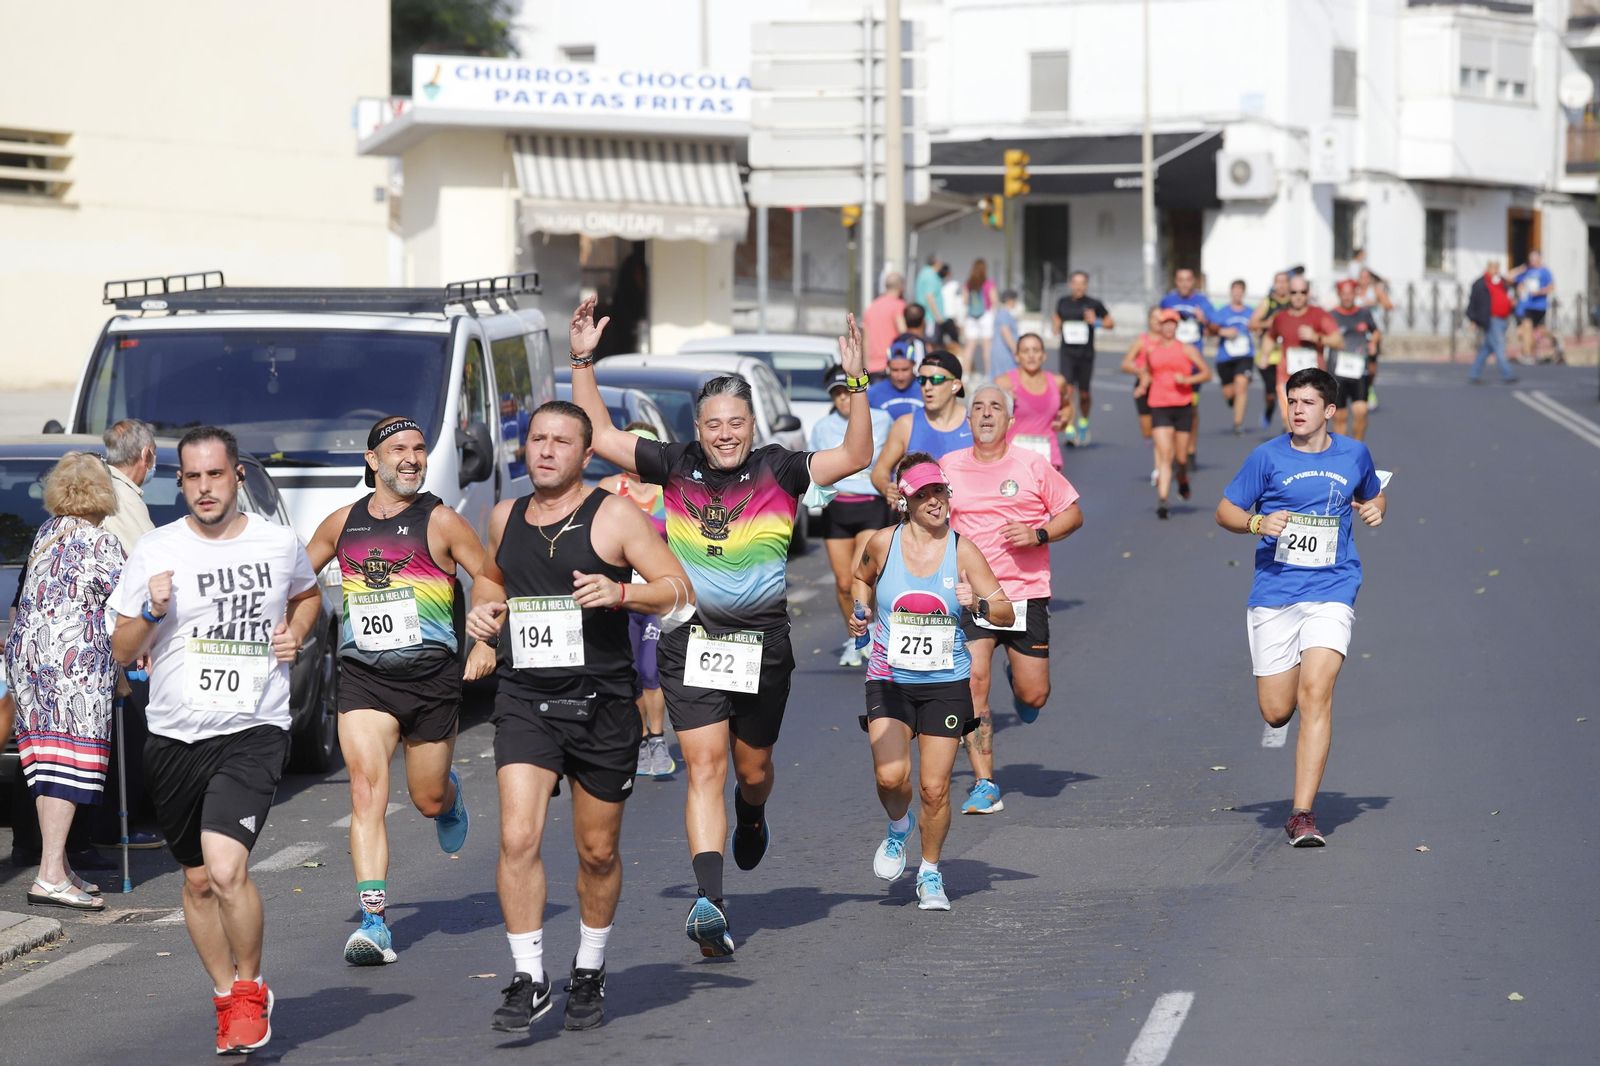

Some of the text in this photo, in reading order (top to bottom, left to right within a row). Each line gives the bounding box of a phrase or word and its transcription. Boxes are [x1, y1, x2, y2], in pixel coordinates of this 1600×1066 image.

[455, 64, 590, 86] CHURROS
[619, 71, 752, 90] CHOCOLA
[494, 89, 734, 113] PATATAS FRITAS
[404, 421, 420, 430] MA
[1293, 470, 1318, 480] VUELTA
[1325, 471, 1348, 486] HUELVA
[1291, 515, 1337, 527] VUELTA A HUELVA
[1287, 533, 1318, 553] 240
[197, 562, 272, 596] PUSH
[212, 591, 266, 622] THE
[357, 594, 379, 604] VUELTA
[380, 593, 385, 602] A
[385, 589, 410, 601] HUELVA
[518, 601, 541, 611] VUELTA
[541, 600, 547, 610] A
[548, 599, 575, 610] HUELVA
[361, 613, 394, 636] 260
[895, 615, 952, 626] 34 VUELTA A HUELVA
[519, 625, 554, 649] 194
[727, 634, 733, 642] A
[734, 633, 758, 644] HUELVA
[900, 635, 933, 656] 275
[202, 642, 229, 654] VUELTA
[231, 644, 237, 655] A
[238, 644, 263, 655] HUELVA
[699, 651, 735, 674] 622
[199, 668, 240, 693] 570
